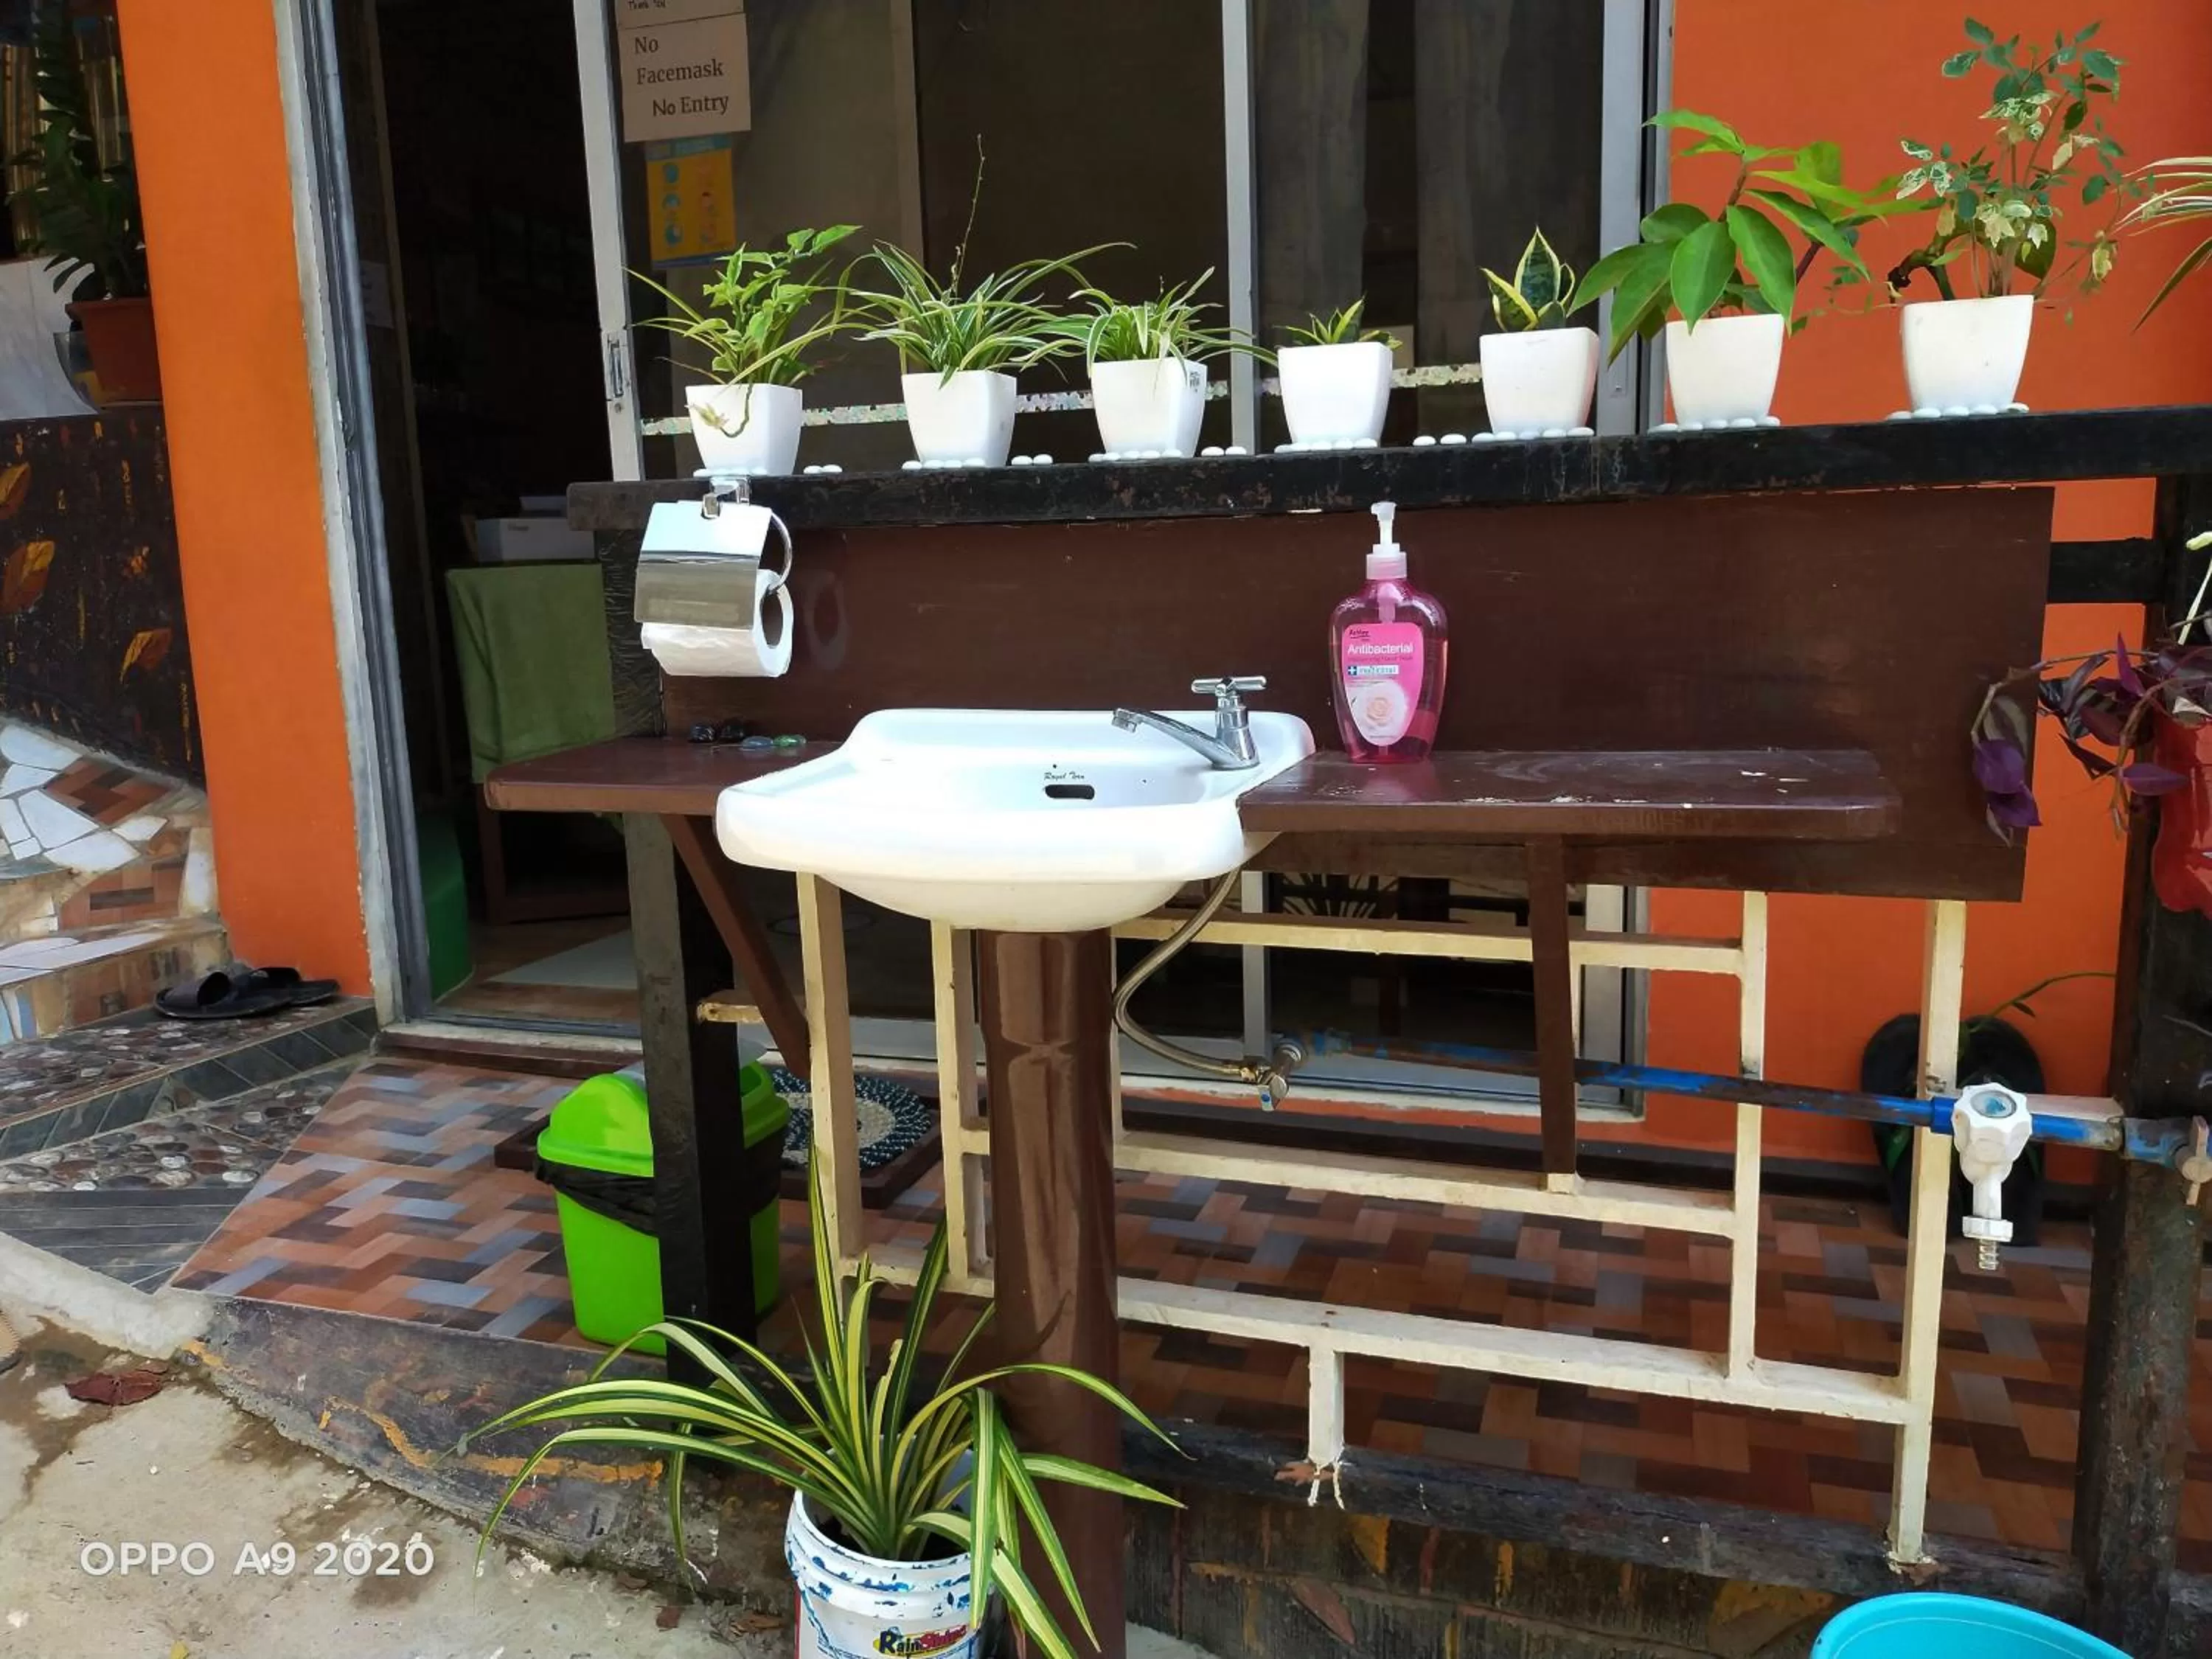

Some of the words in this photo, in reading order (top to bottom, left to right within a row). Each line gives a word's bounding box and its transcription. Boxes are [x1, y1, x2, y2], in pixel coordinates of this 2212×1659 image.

[634, 36, 659, 54] No
[636, 58, 724, 85] Facemask
[653, 99, 676, 116] No
[680, 95, 728, 116] Entry
[1348, 642, 1413, 655] Antibacterial
